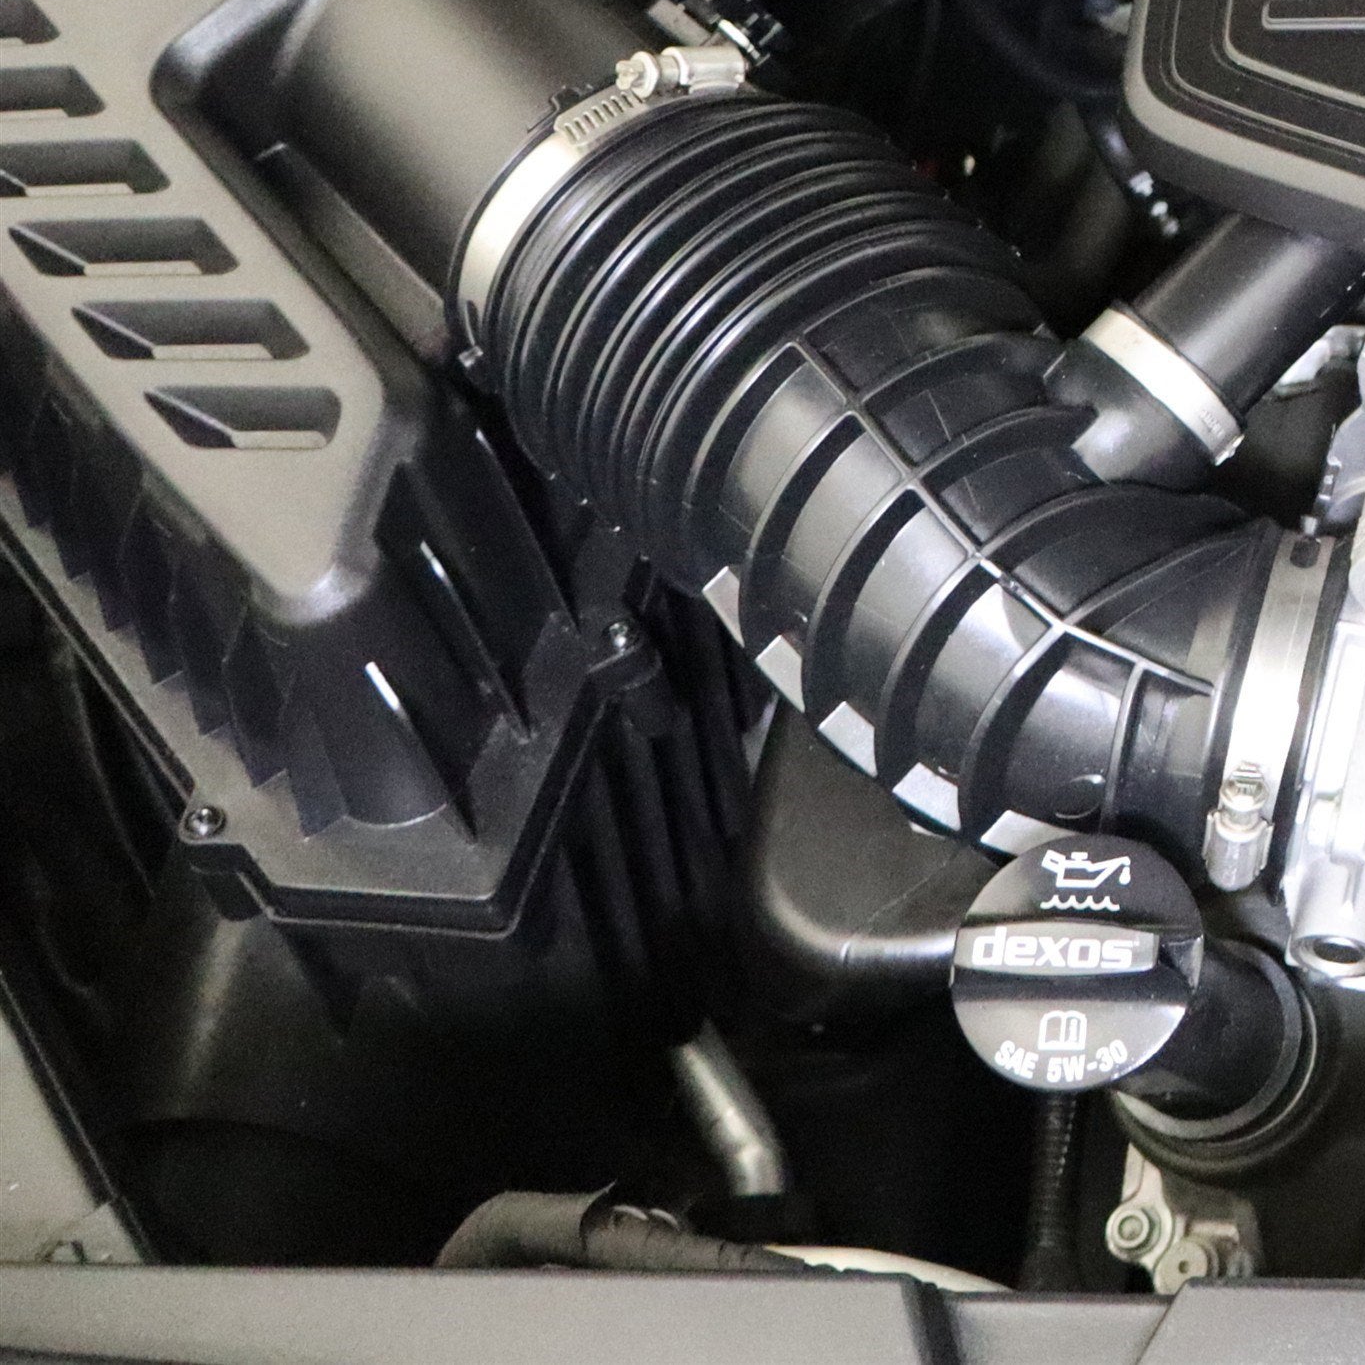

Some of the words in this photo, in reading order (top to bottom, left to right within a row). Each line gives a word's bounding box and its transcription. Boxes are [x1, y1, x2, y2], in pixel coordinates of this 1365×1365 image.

[972, 926, 1134, 969] dexos
[994, 1039, 1039, 1079] SAE
[1046, 1038, 1129, 1083] 5W-30
